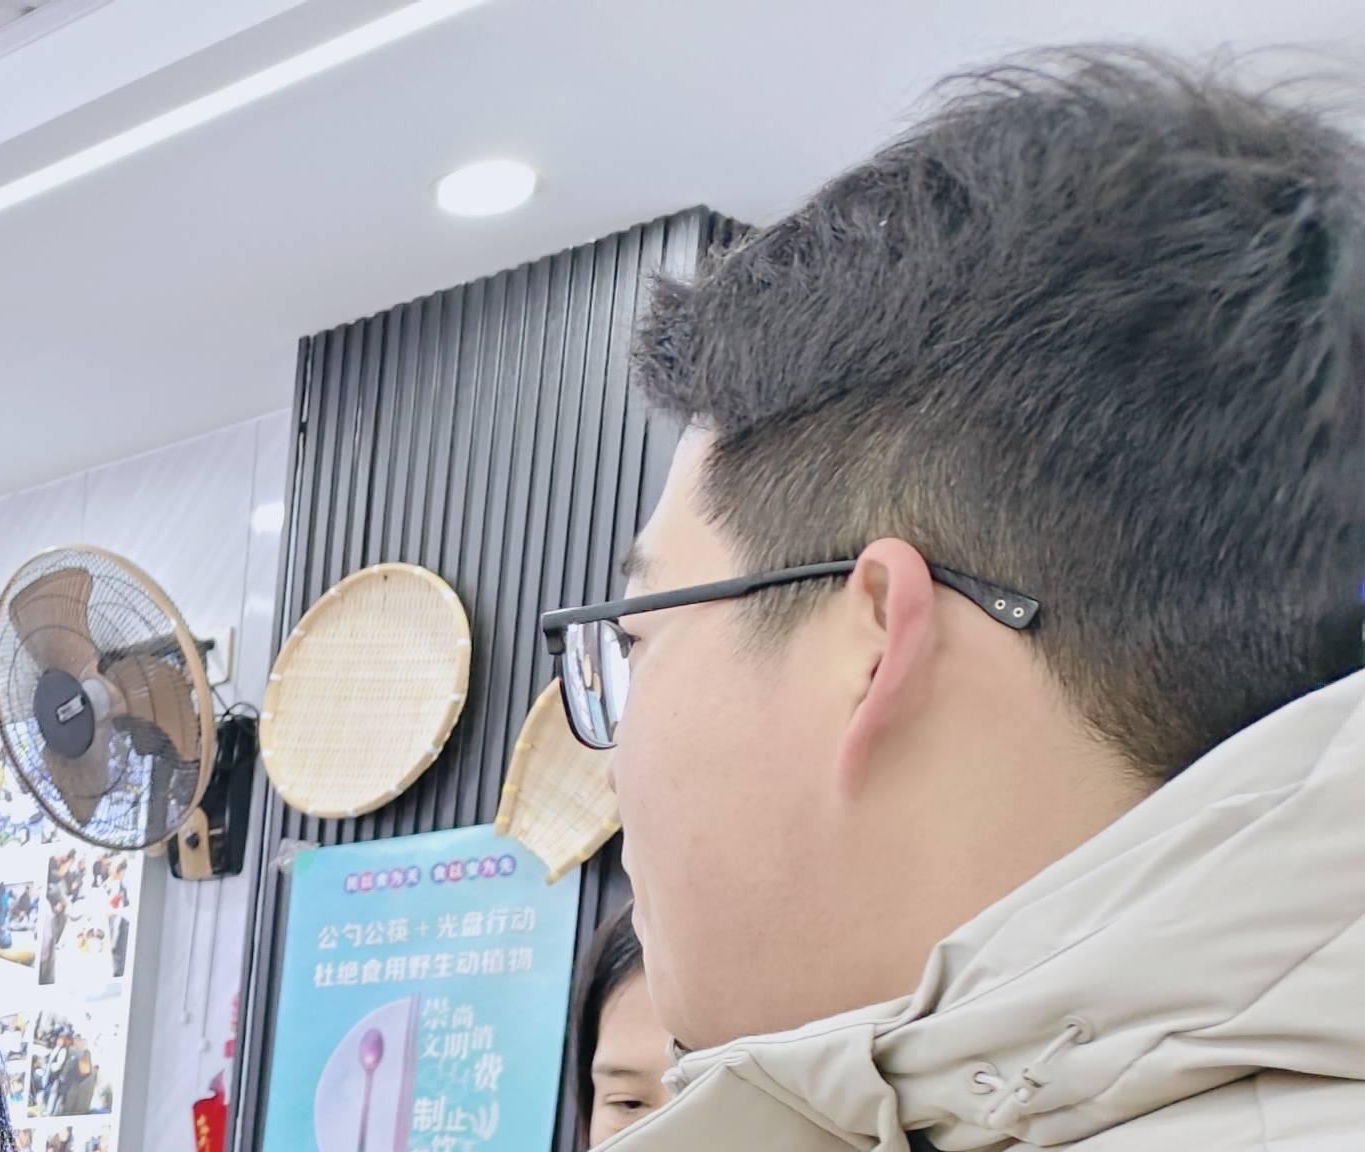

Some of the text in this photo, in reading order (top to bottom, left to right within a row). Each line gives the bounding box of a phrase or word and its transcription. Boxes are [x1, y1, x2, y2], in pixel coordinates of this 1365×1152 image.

[313, 949, 534, 988] 杜绝食用野生动植物
